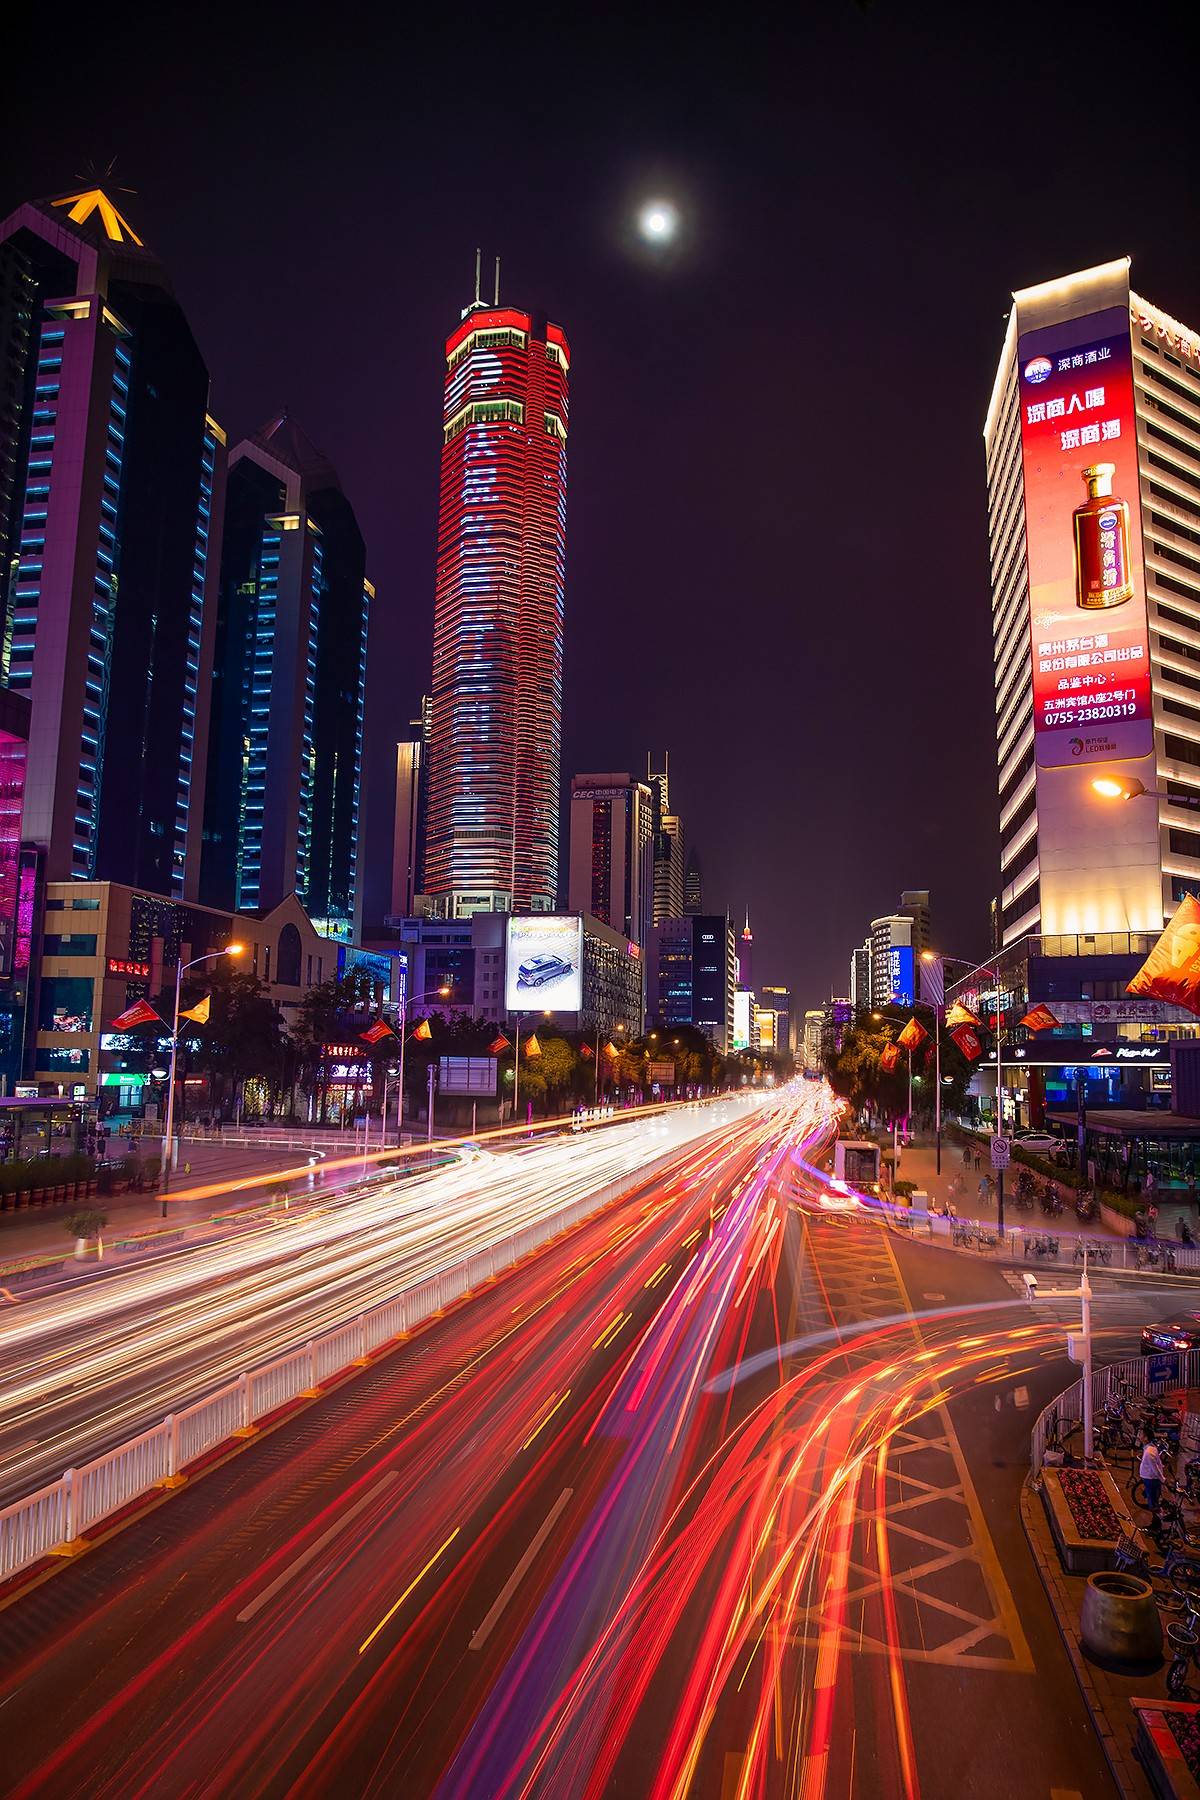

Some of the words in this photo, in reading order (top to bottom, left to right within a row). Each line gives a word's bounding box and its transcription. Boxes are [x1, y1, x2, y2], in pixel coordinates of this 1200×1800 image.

[1058, 347, 1111, 371] 深商酒业
[1027, 387, 1105, 424] 深商人喝
[1060, 418, 1121, 450] 深商酒
[1039, 645, 1143, 673] 股份有限公司出品
[1044, 689, 1136, 711] 五洲宾馆A座2号门
[1045, 702, 1136, 726] 0755-23820319
